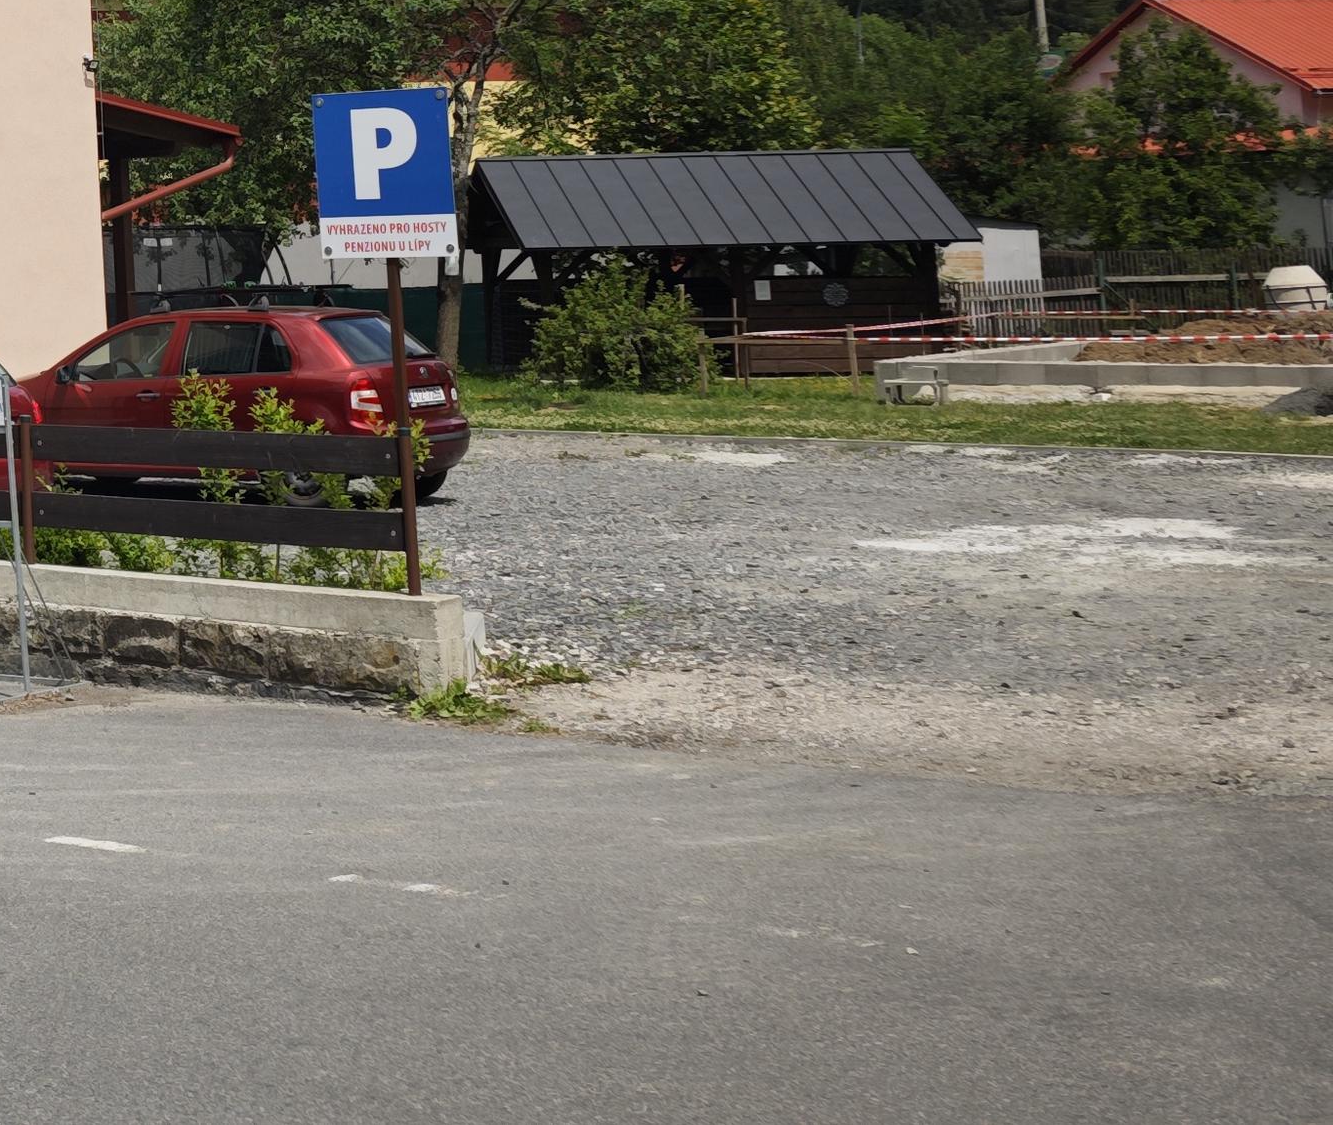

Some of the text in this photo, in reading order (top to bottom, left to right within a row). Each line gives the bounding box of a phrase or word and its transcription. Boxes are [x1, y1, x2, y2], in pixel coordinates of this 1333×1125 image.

[350, 107, 417, 200] P
[327, 221, 447, 236] VYHRAZENO PRO HOSTY
[344, 240, 431, 253] PENZIONU U LÍPY
